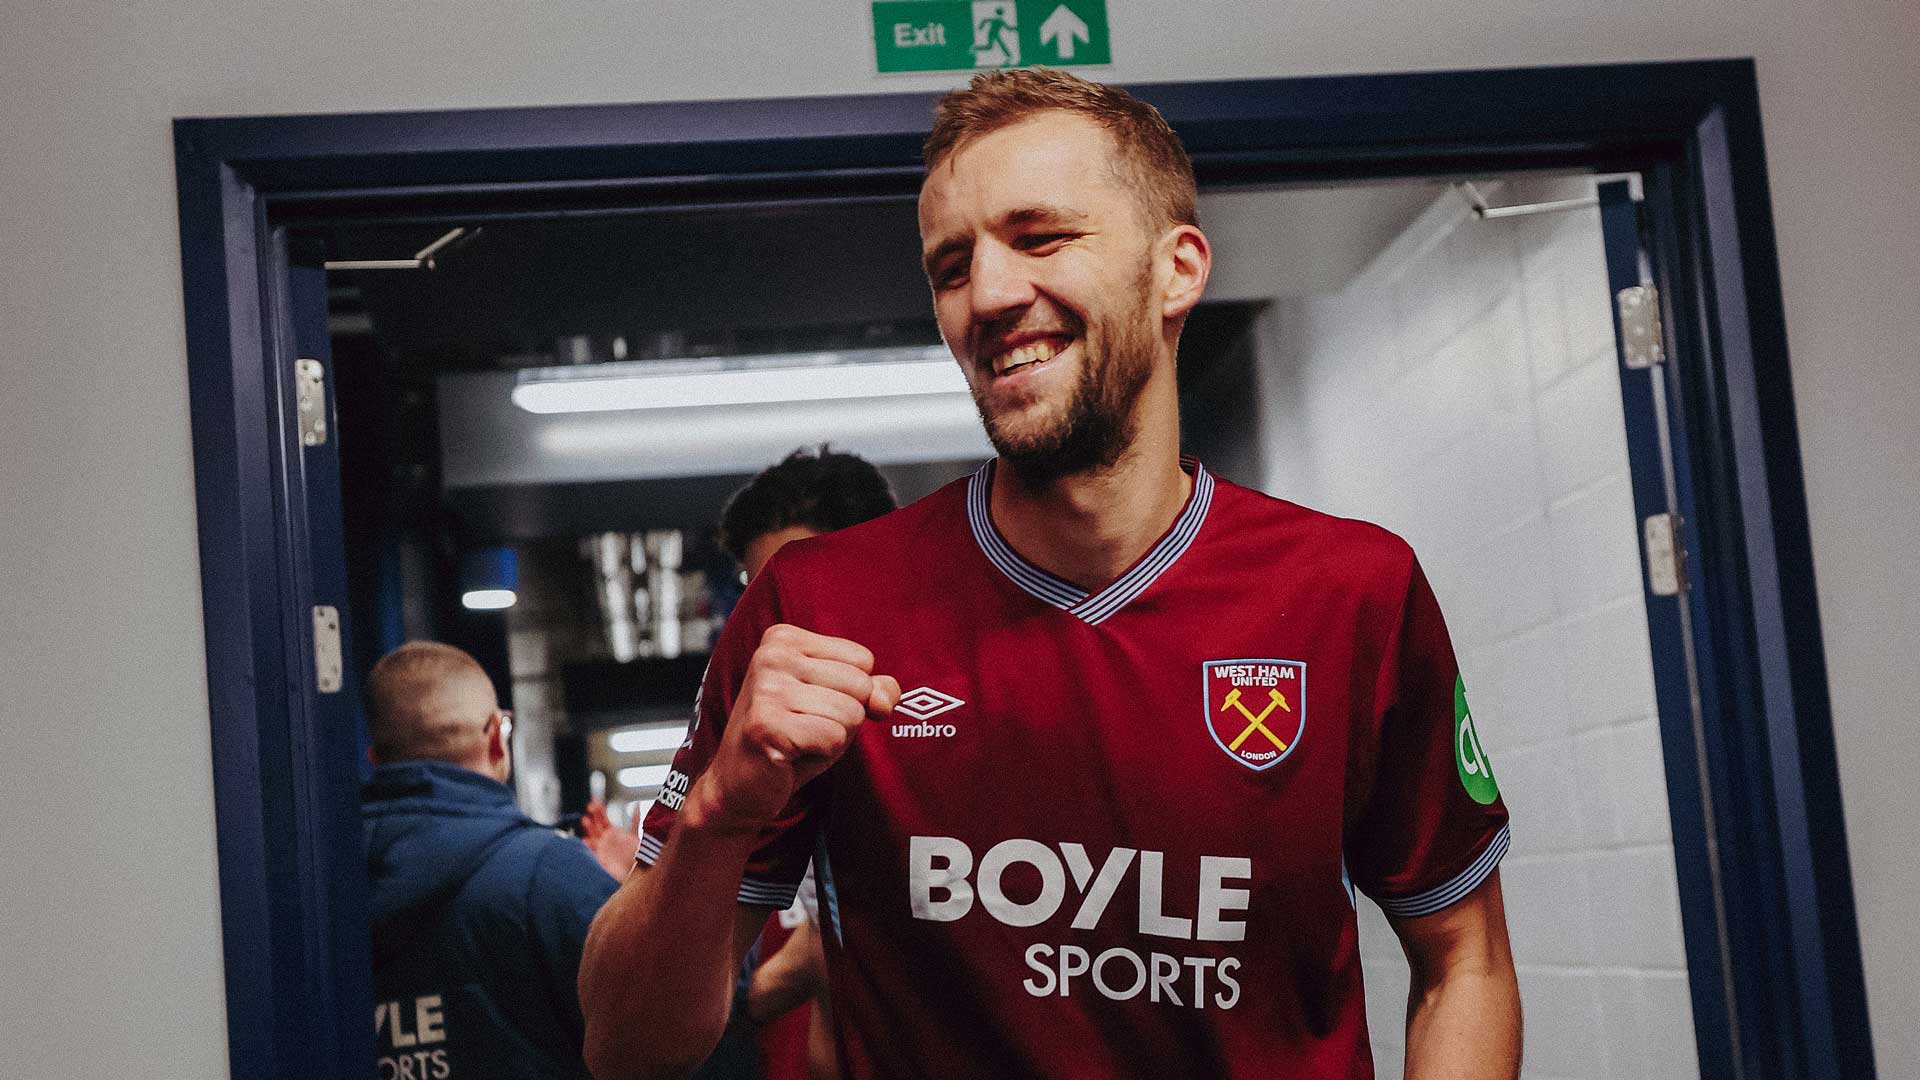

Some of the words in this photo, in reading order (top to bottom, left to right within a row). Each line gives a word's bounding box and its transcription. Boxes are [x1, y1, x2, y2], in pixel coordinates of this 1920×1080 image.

[894, 22, 946, 48] Exit
[1214, 665, 1256, 678] WEST
[1258, 665, 1295, 679] HAM
[1231, 676, 1278, 687] UNITED
[892, 721, 956, 738] umbro
[1241, 750, 1277, 760] LONDON
[910, 836, 1251, 941] BOYLE
[1023, 943, 1242, 1009] SPORTS
